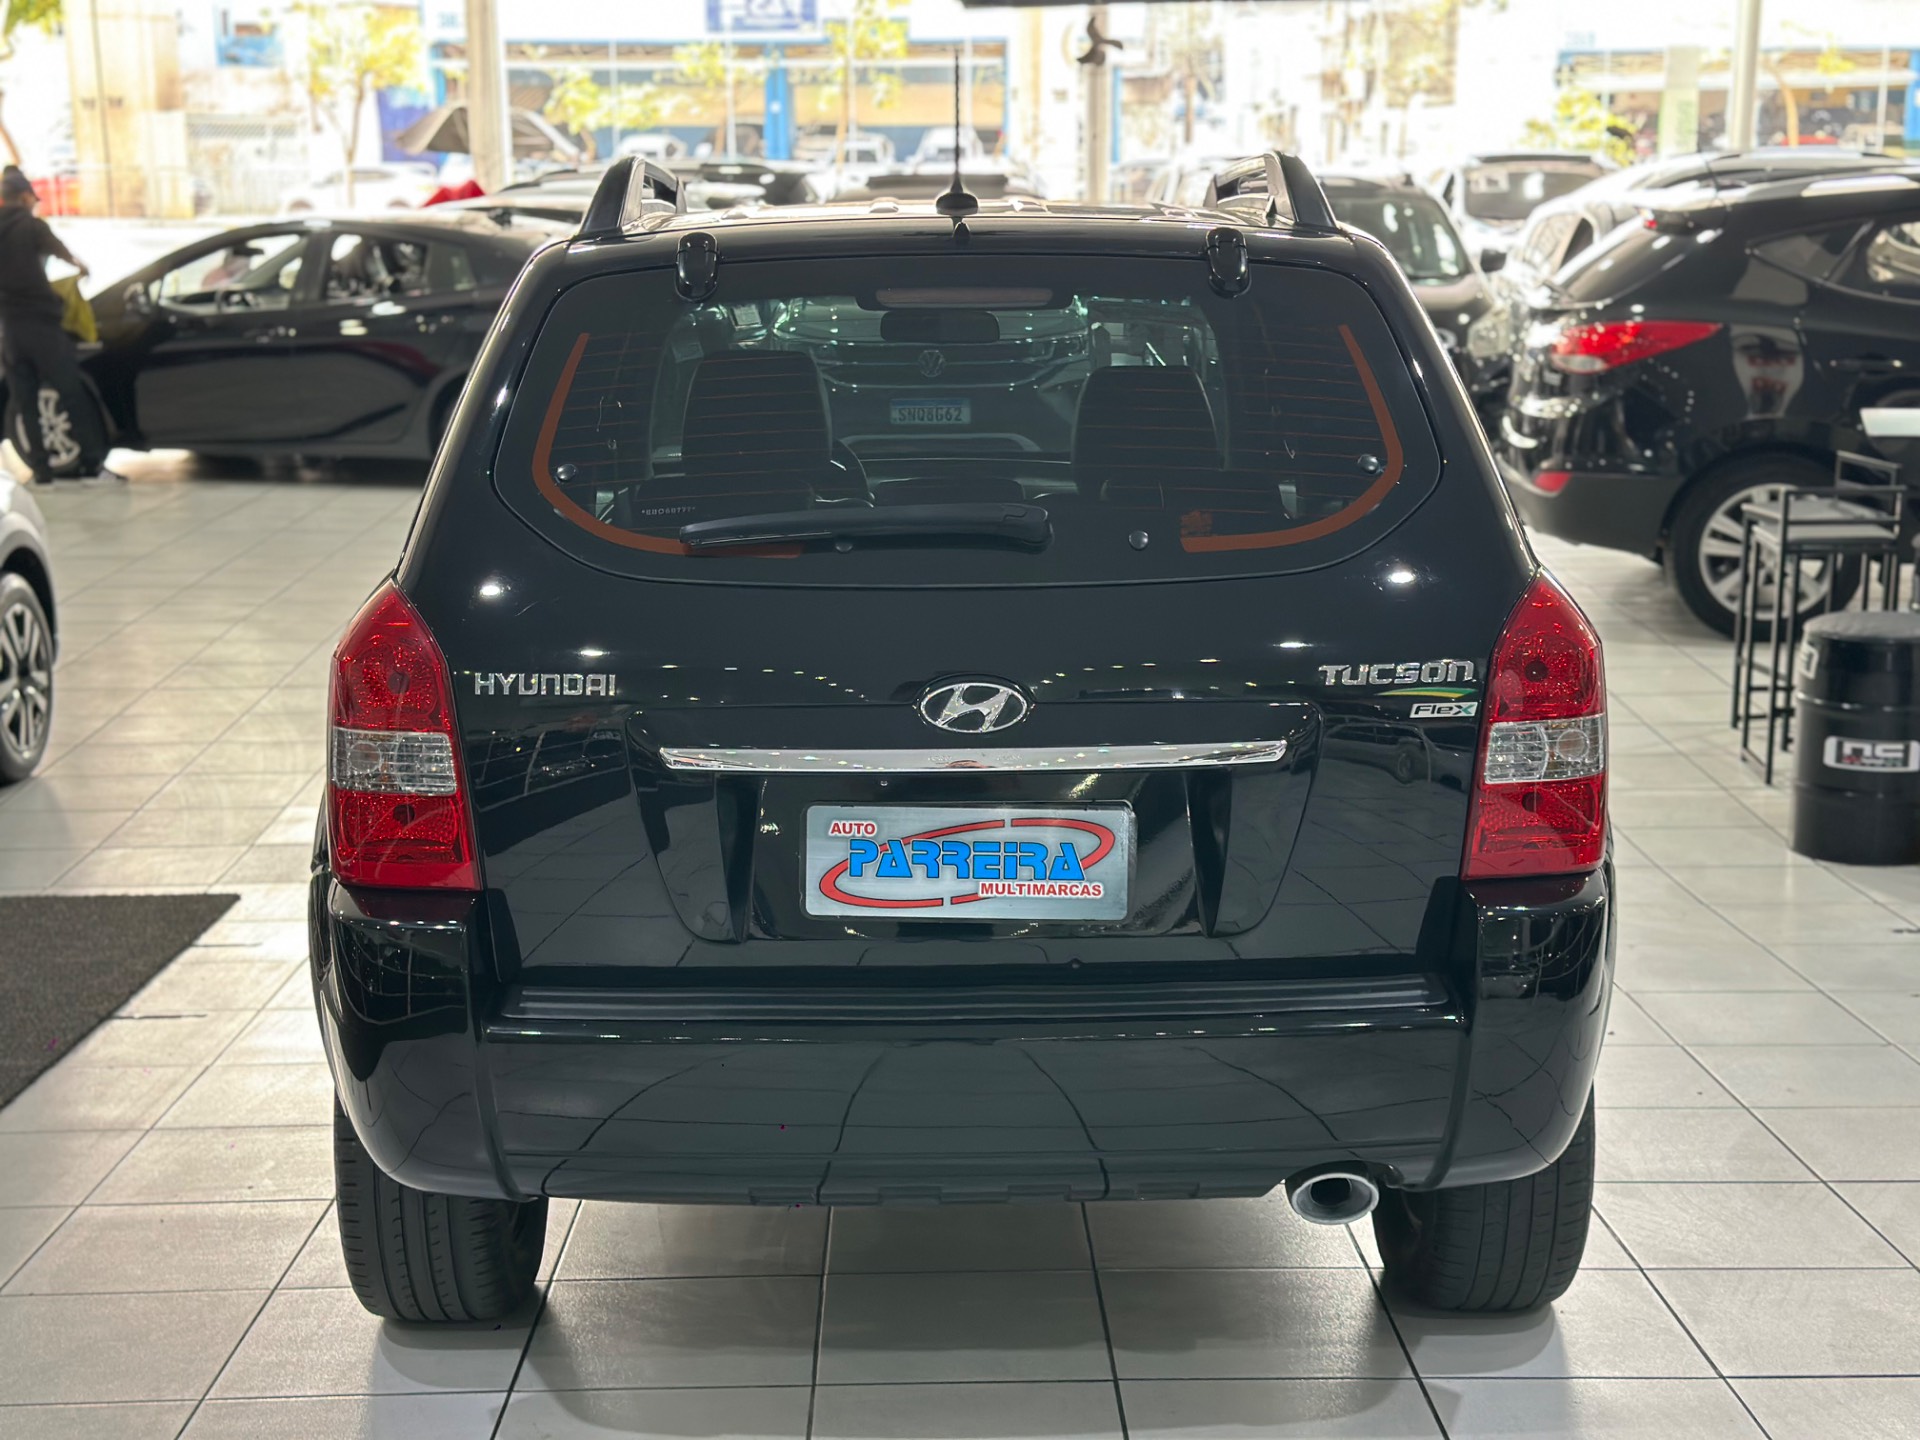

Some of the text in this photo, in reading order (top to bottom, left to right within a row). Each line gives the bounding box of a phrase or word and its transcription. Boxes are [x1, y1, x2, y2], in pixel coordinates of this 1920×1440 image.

[474, 672, 616, 696] HYUNDAI
[1318, 659, 1477, 686] TUCSON
[830, 822, 876, 835] AUTO
[849, 839, 1085, 881] PARREIRA
[980, 883, 1102, 897] MULTIMARCAS
